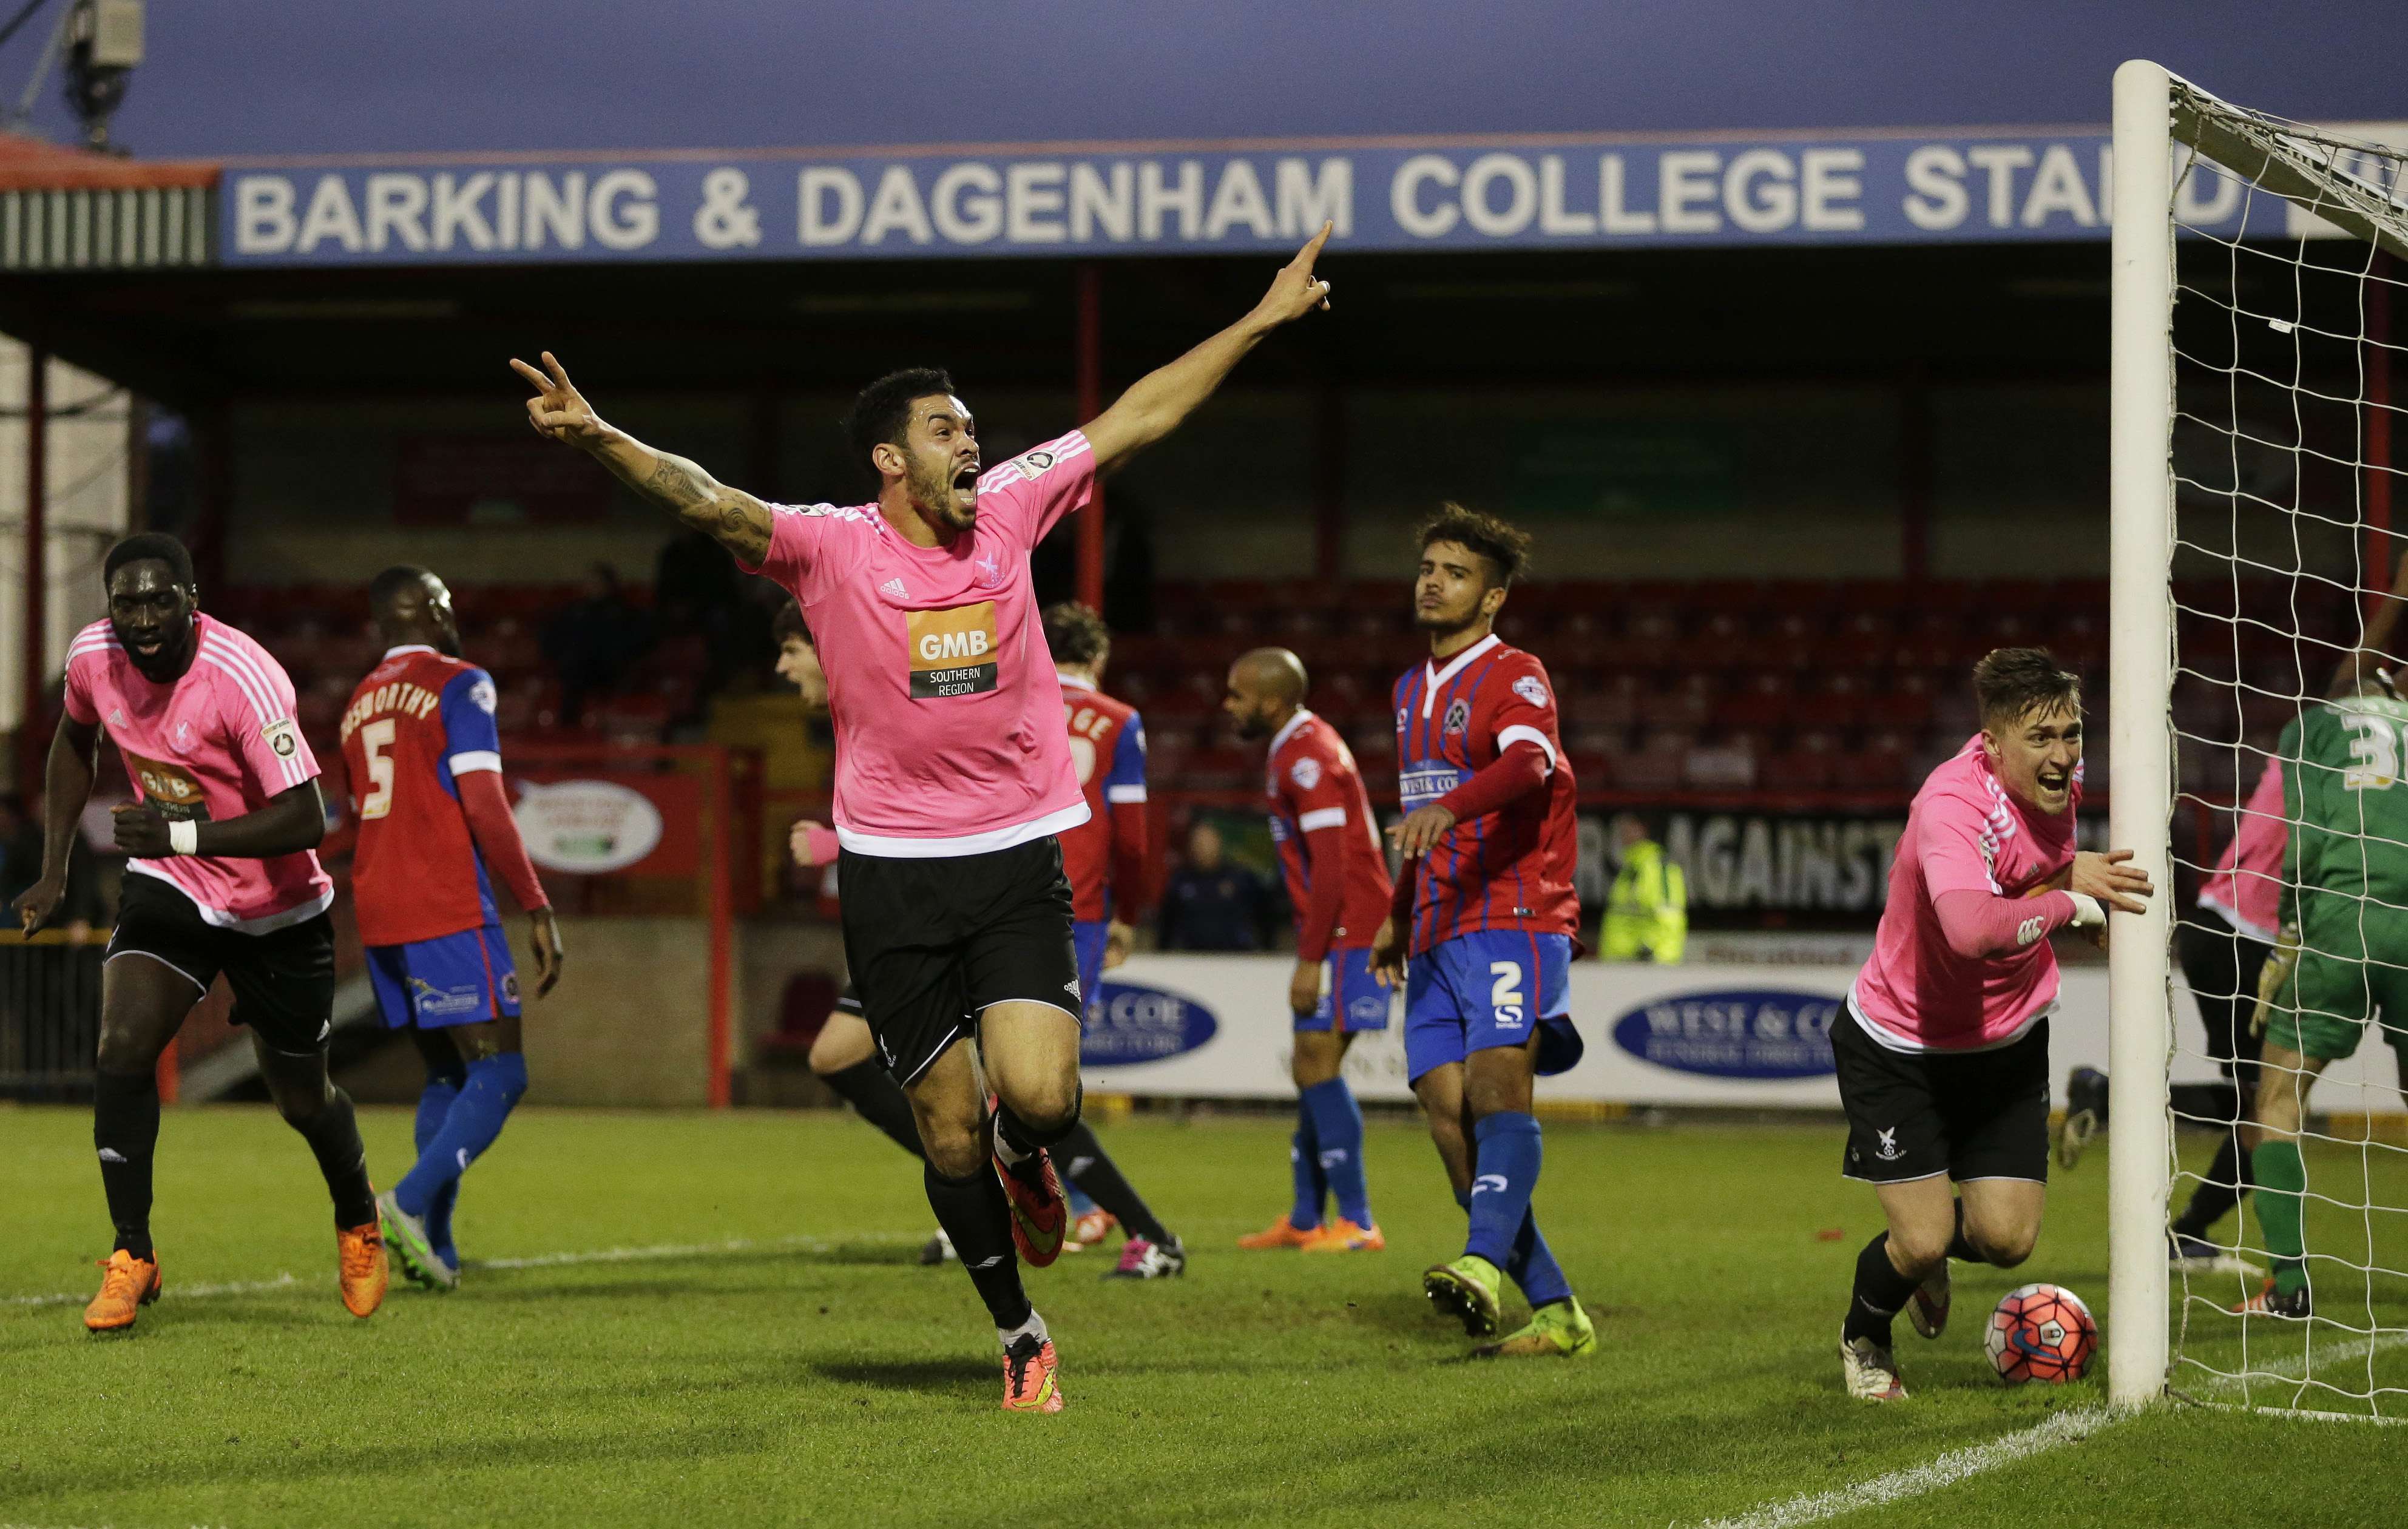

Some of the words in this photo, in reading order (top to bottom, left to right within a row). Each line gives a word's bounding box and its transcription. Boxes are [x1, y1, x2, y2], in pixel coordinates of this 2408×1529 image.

[235, 169, 659, 253] BARKING
[694, 166, 763, 249] &
[797, 158, 1353, 246] DAGENHAM
[1390, 149, 1865, 238] COLLEGE
[1903, 143, 2244, 231] STAD
[880, 586, 910, 599] adidas
[919, 630, 989, 661] GMB
[930, 667, 981, 684] SOUTHERN
[938, 682, 974, 697] REGION
[360, 718, 396, 820] 5
[1490, 960, 1523, 1007] 2
